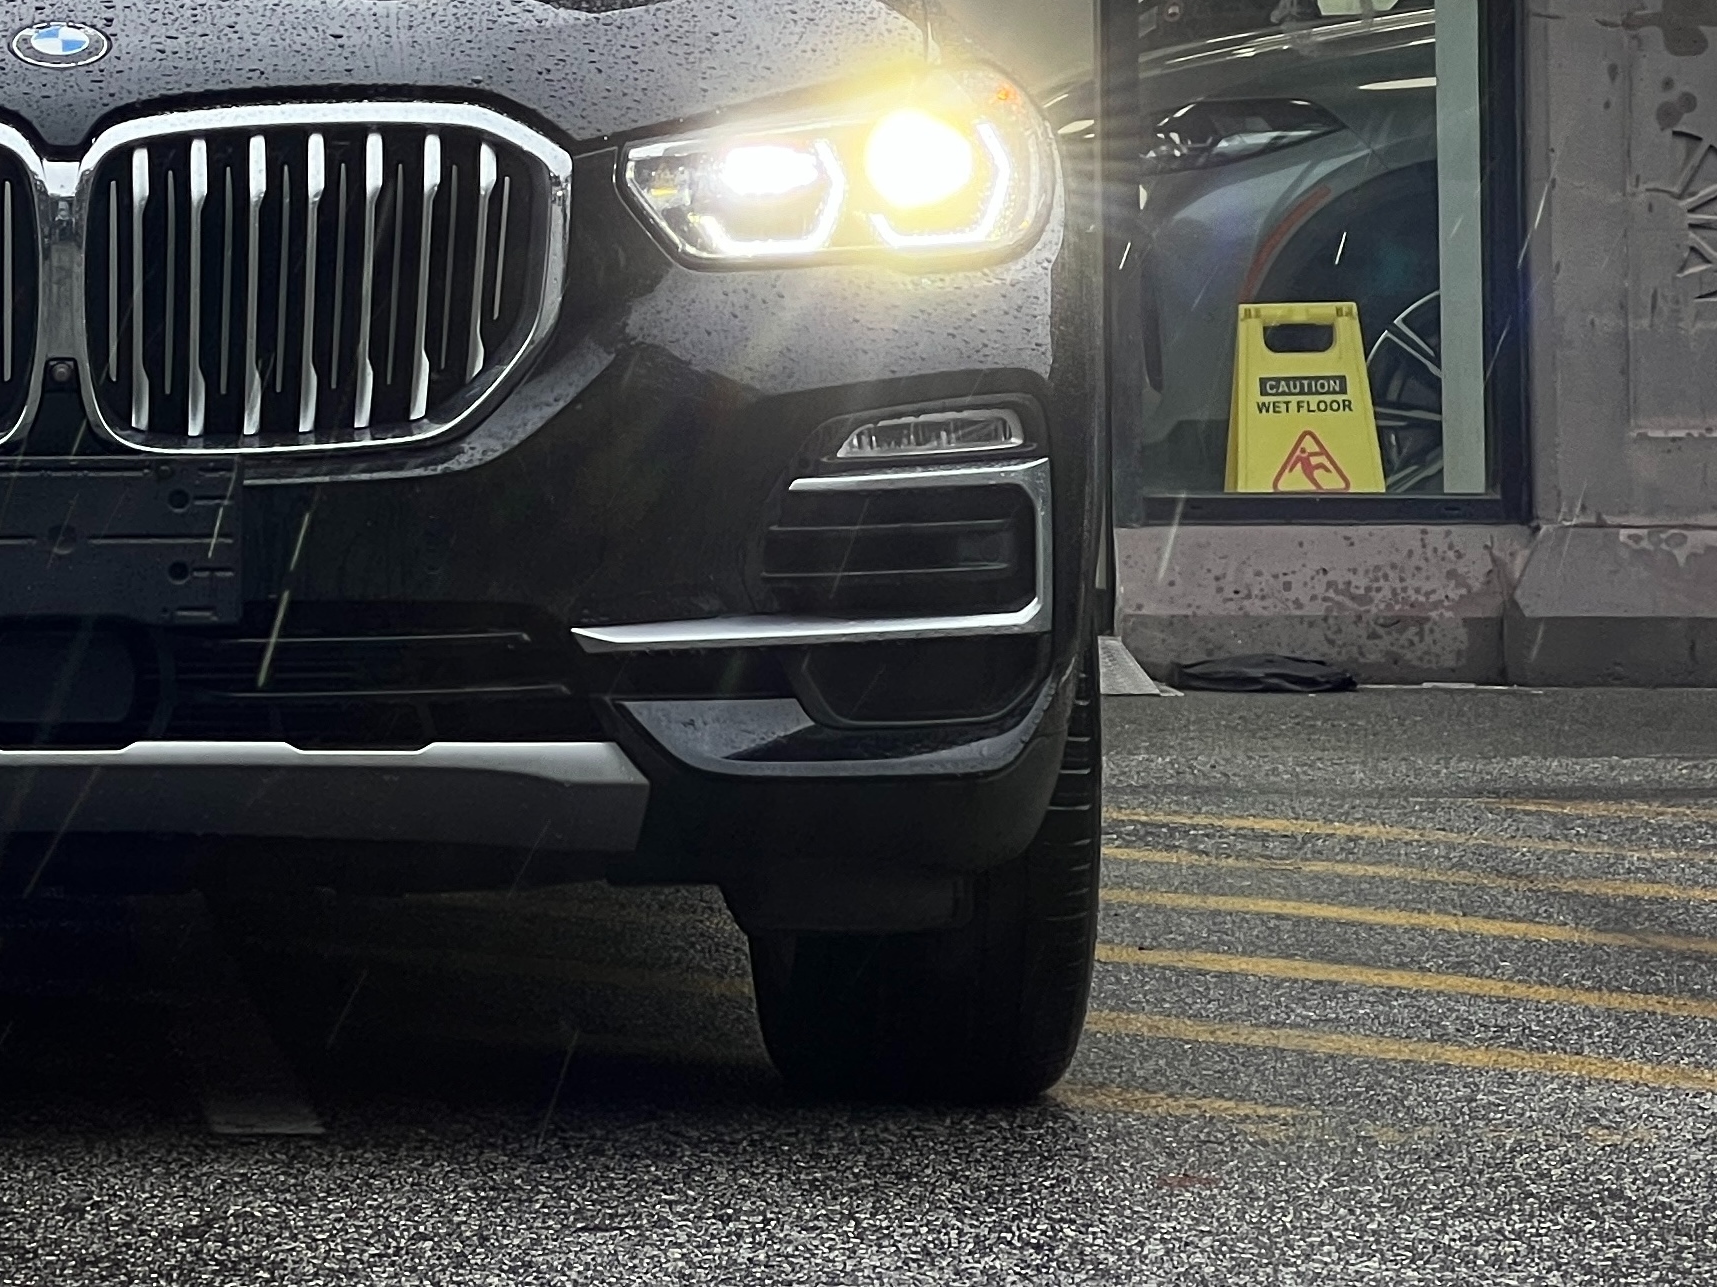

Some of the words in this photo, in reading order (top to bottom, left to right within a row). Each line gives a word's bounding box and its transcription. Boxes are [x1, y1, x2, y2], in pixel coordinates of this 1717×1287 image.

[1266, 379, 1340, 394] CAUTION
[1256, 400, 1292, 414] WET
[1296, 399, 1353, 413] FLOOR
